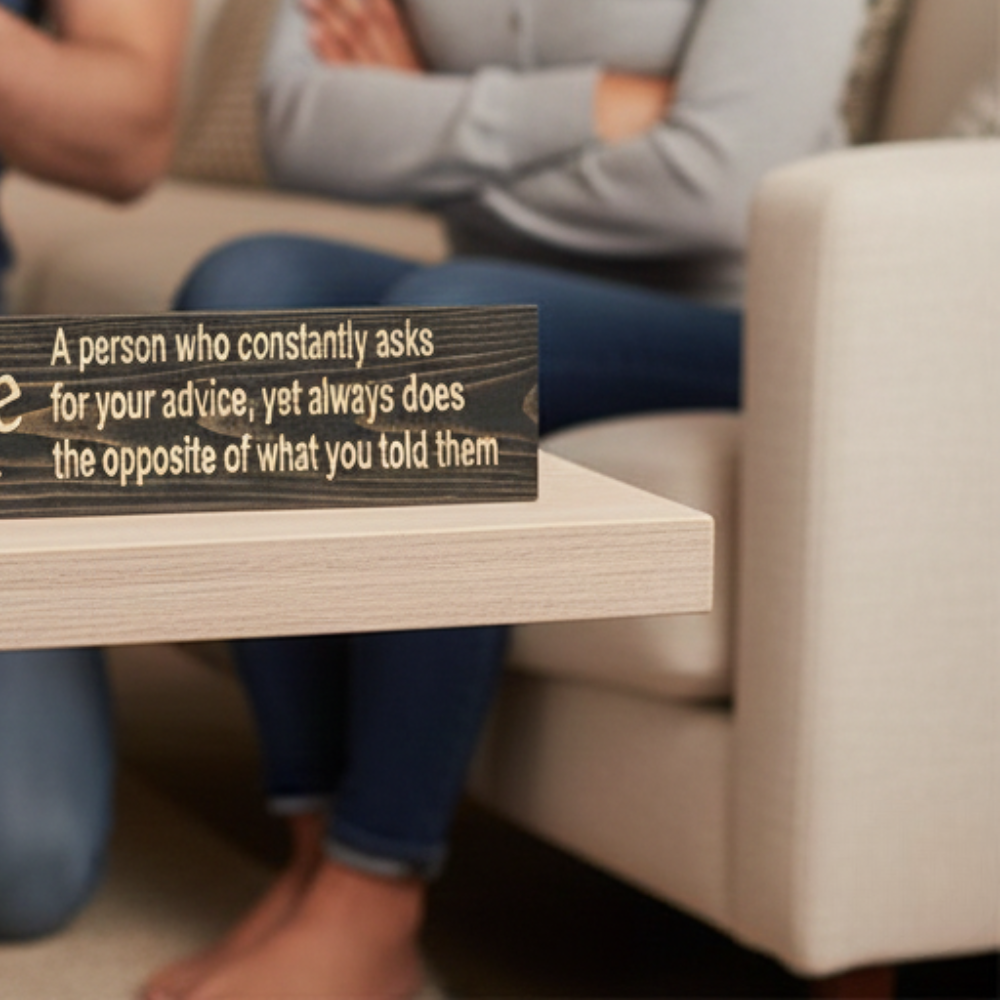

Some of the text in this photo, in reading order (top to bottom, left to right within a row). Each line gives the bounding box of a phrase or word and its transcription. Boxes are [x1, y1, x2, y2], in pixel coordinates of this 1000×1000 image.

[50, 318, 434, 372] A person who constantly asks
[49, 372, 466, 430] for your advice, yet always does
[52, 429, 499, 487] the opposite of what you told them
